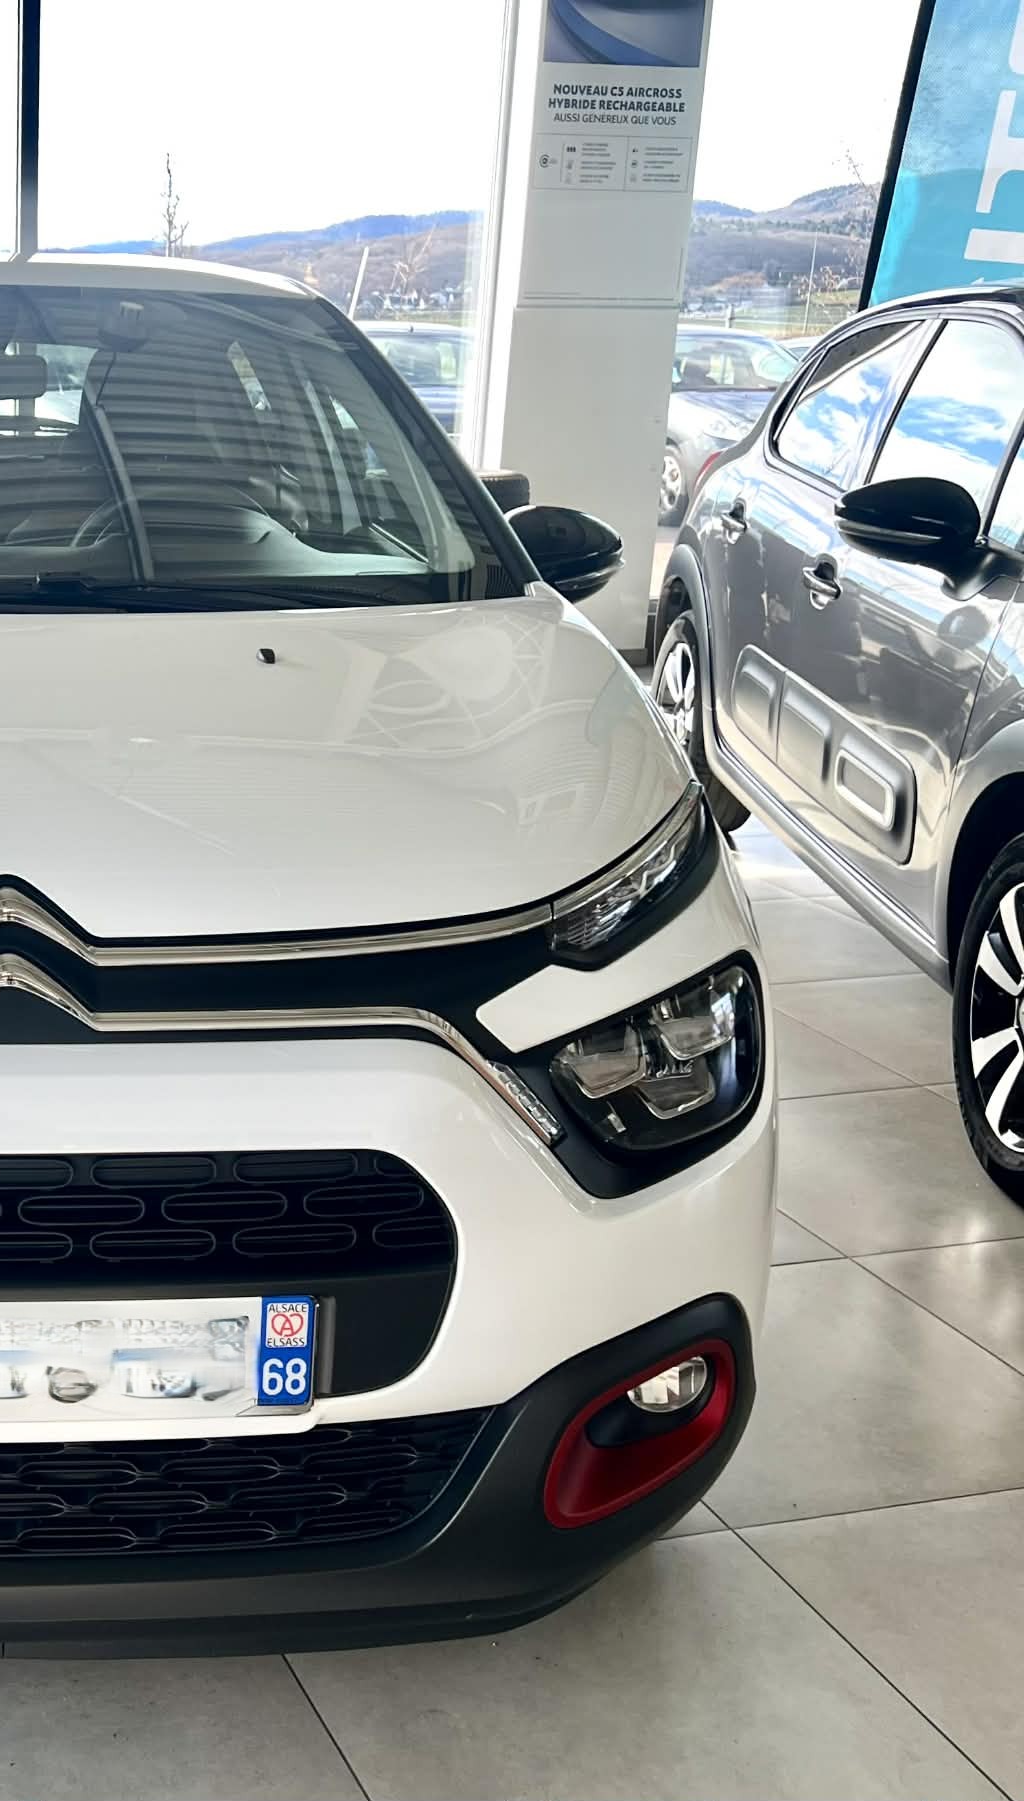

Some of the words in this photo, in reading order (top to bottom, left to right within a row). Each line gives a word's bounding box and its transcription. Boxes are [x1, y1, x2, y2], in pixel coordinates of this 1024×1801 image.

[553, 84, 608, 96] NOUVEAU
[610, 86, 624, 96] C5
[626, 86, 682, 99] AIRCROSS
[548, 98, 597, 110] HYBRIDE
[598, 100, 686, 113] RECHARGEABLE
[553, 113, 581, 123] AUSSI
[630, 115, 649, 126] QUE
[651, 116, 677, 126] VOUS
[268, 1303, 308, 1313] ALSACE
[266, 1338, 305, 1348] ELSASS
[262, 1358, 307, 1396] 68
